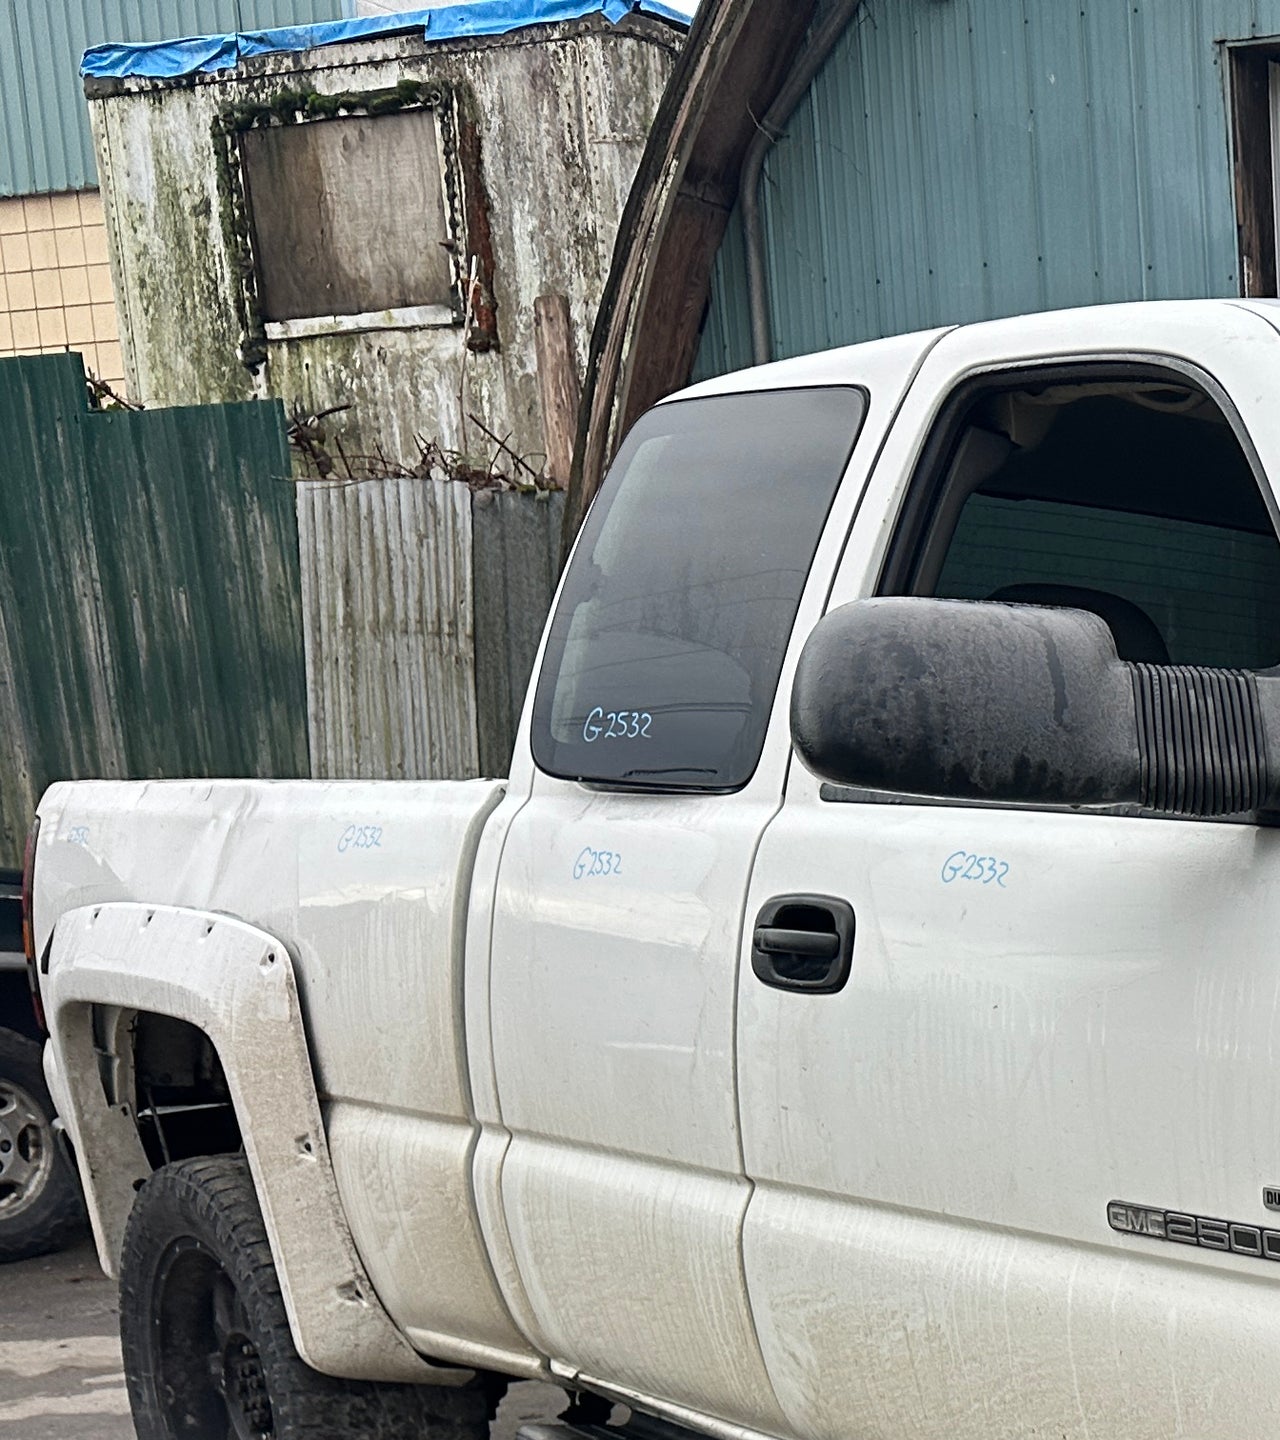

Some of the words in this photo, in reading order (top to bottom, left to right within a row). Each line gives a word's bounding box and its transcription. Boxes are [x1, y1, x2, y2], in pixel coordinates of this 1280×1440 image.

[583, 706, 652, 742] G2532
[572, 846, 623, 880] G2532
[941, 850, 1009, 888] G2532
